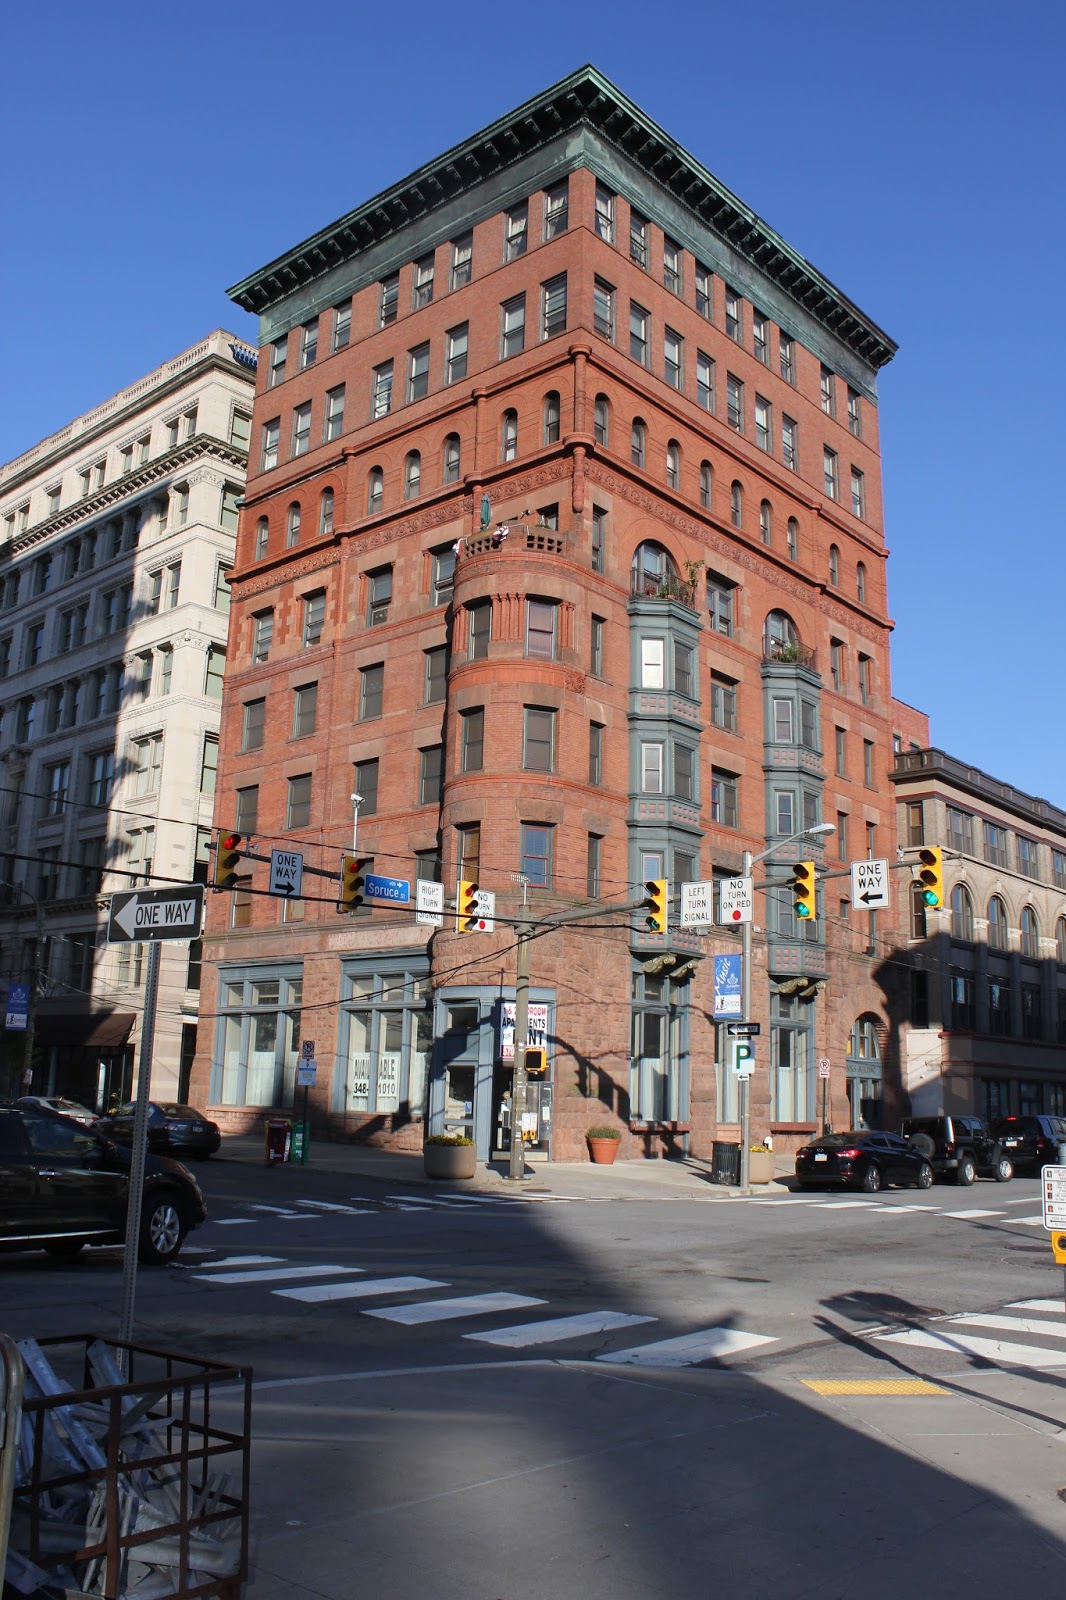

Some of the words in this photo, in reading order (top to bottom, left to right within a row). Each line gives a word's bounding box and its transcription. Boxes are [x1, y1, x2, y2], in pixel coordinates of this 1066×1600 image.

[277, 854, 297, 868] ONE
[276, 866, 297, 880] WAY
[858, 863, 882, 876] ONE
[730, 880, 744, 890] NO
[858, 876, 882, 889] WAY
[368, 882, 399, 898] Spruce
[421, 885, 439, 897] RIGHT
[688, 886, 705, 897] LEFT
[728, 890, 746, 899] TURN
[423, 898, 438, 908] TURN
[477, 893, 488, 902] NO
[478, 903, 491, 911] URN
[688, 899, 706, 909] TURN
[723, 902, 733, 910] ON
[737, 900, 751, 908] RED
[135, 905, 160, 926] ONE
[165, 902, 192, 924] WAY
[419, 911, 440, 921] SIGNAL
[684, 911, 709, 922] SIGNAL
[714, 957, 731, 996] Music
[526, 1006, 547, 1016] ROOM
[502, 1017, 546, 1029] APAENTS
